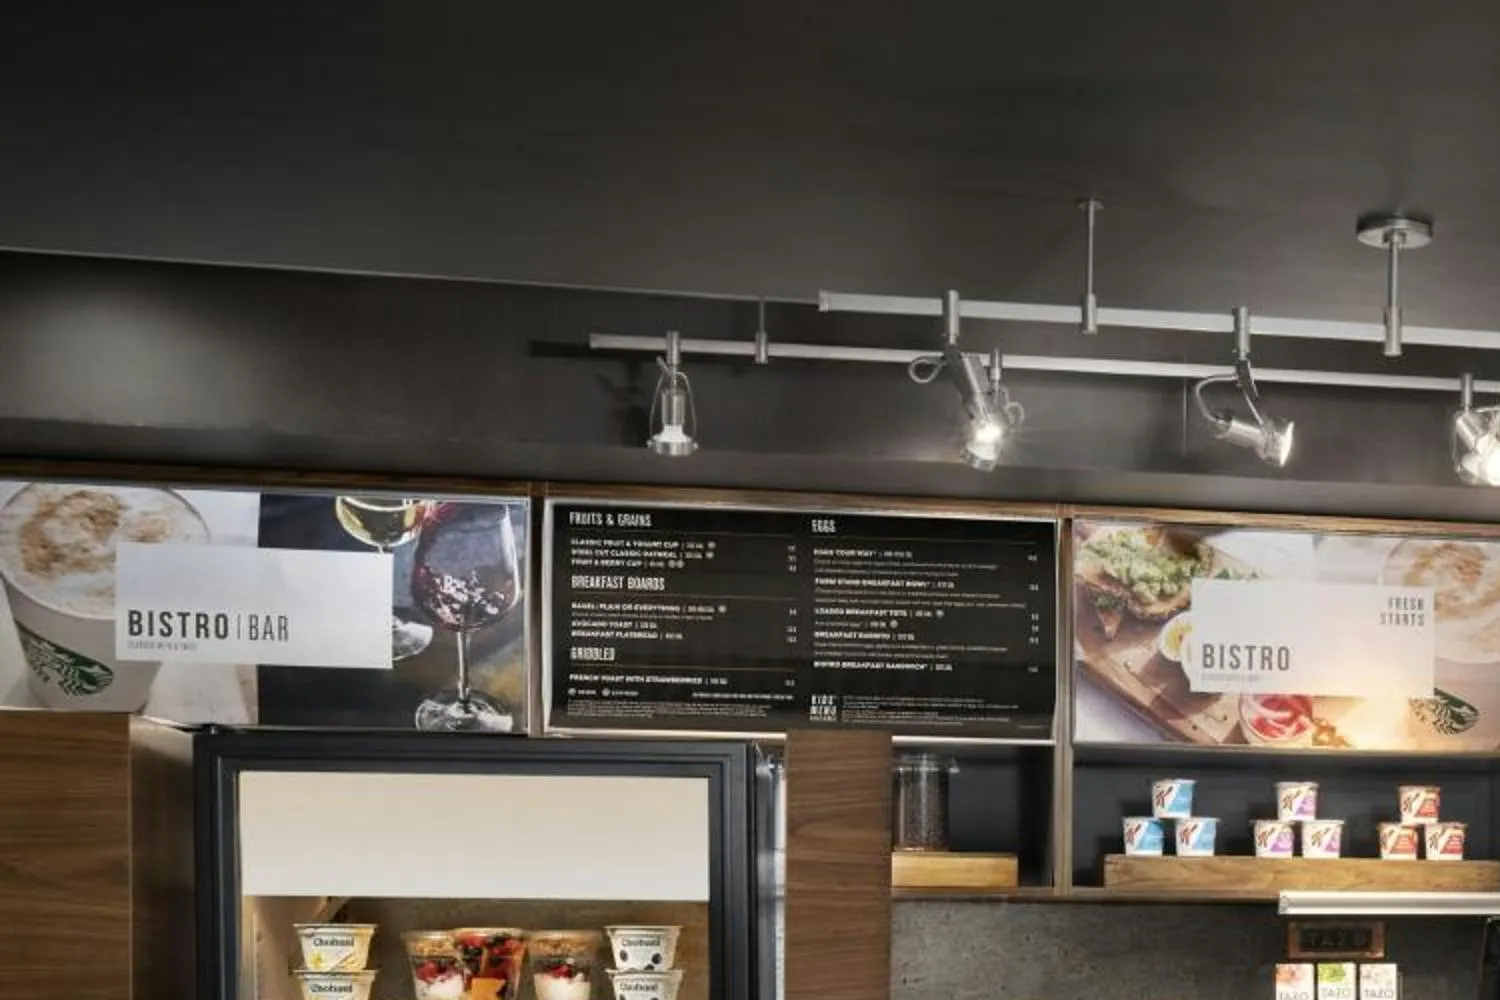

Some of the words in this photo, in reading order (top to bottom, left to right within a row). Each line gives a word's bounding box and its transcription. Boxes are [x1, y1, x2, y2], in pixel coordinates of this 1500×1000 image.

[569, 511, 603, 526] FRUITS
[606, 513, 614, 526] &
[617, 513, 653, 527] GRAINS
[571, 575, 625, 589] BREAKFAST
[627, 577, 665, 591] BOARDS
[1388, 596, 1425, 611] FRESH
[127, 609, 229, 640] BISTRO
[249, 614, 290, 642] BAR
[1380, 611, 1425, 626] STARTS
[1202, 644, 1290, 671] BISTRO
[313, 937, 355, 947] Chobani
[310, 983, 353, 993] Chobani
[1321, 987, 1351, 998] TAZO
[1364, 988, 1394, 999] TAZO
